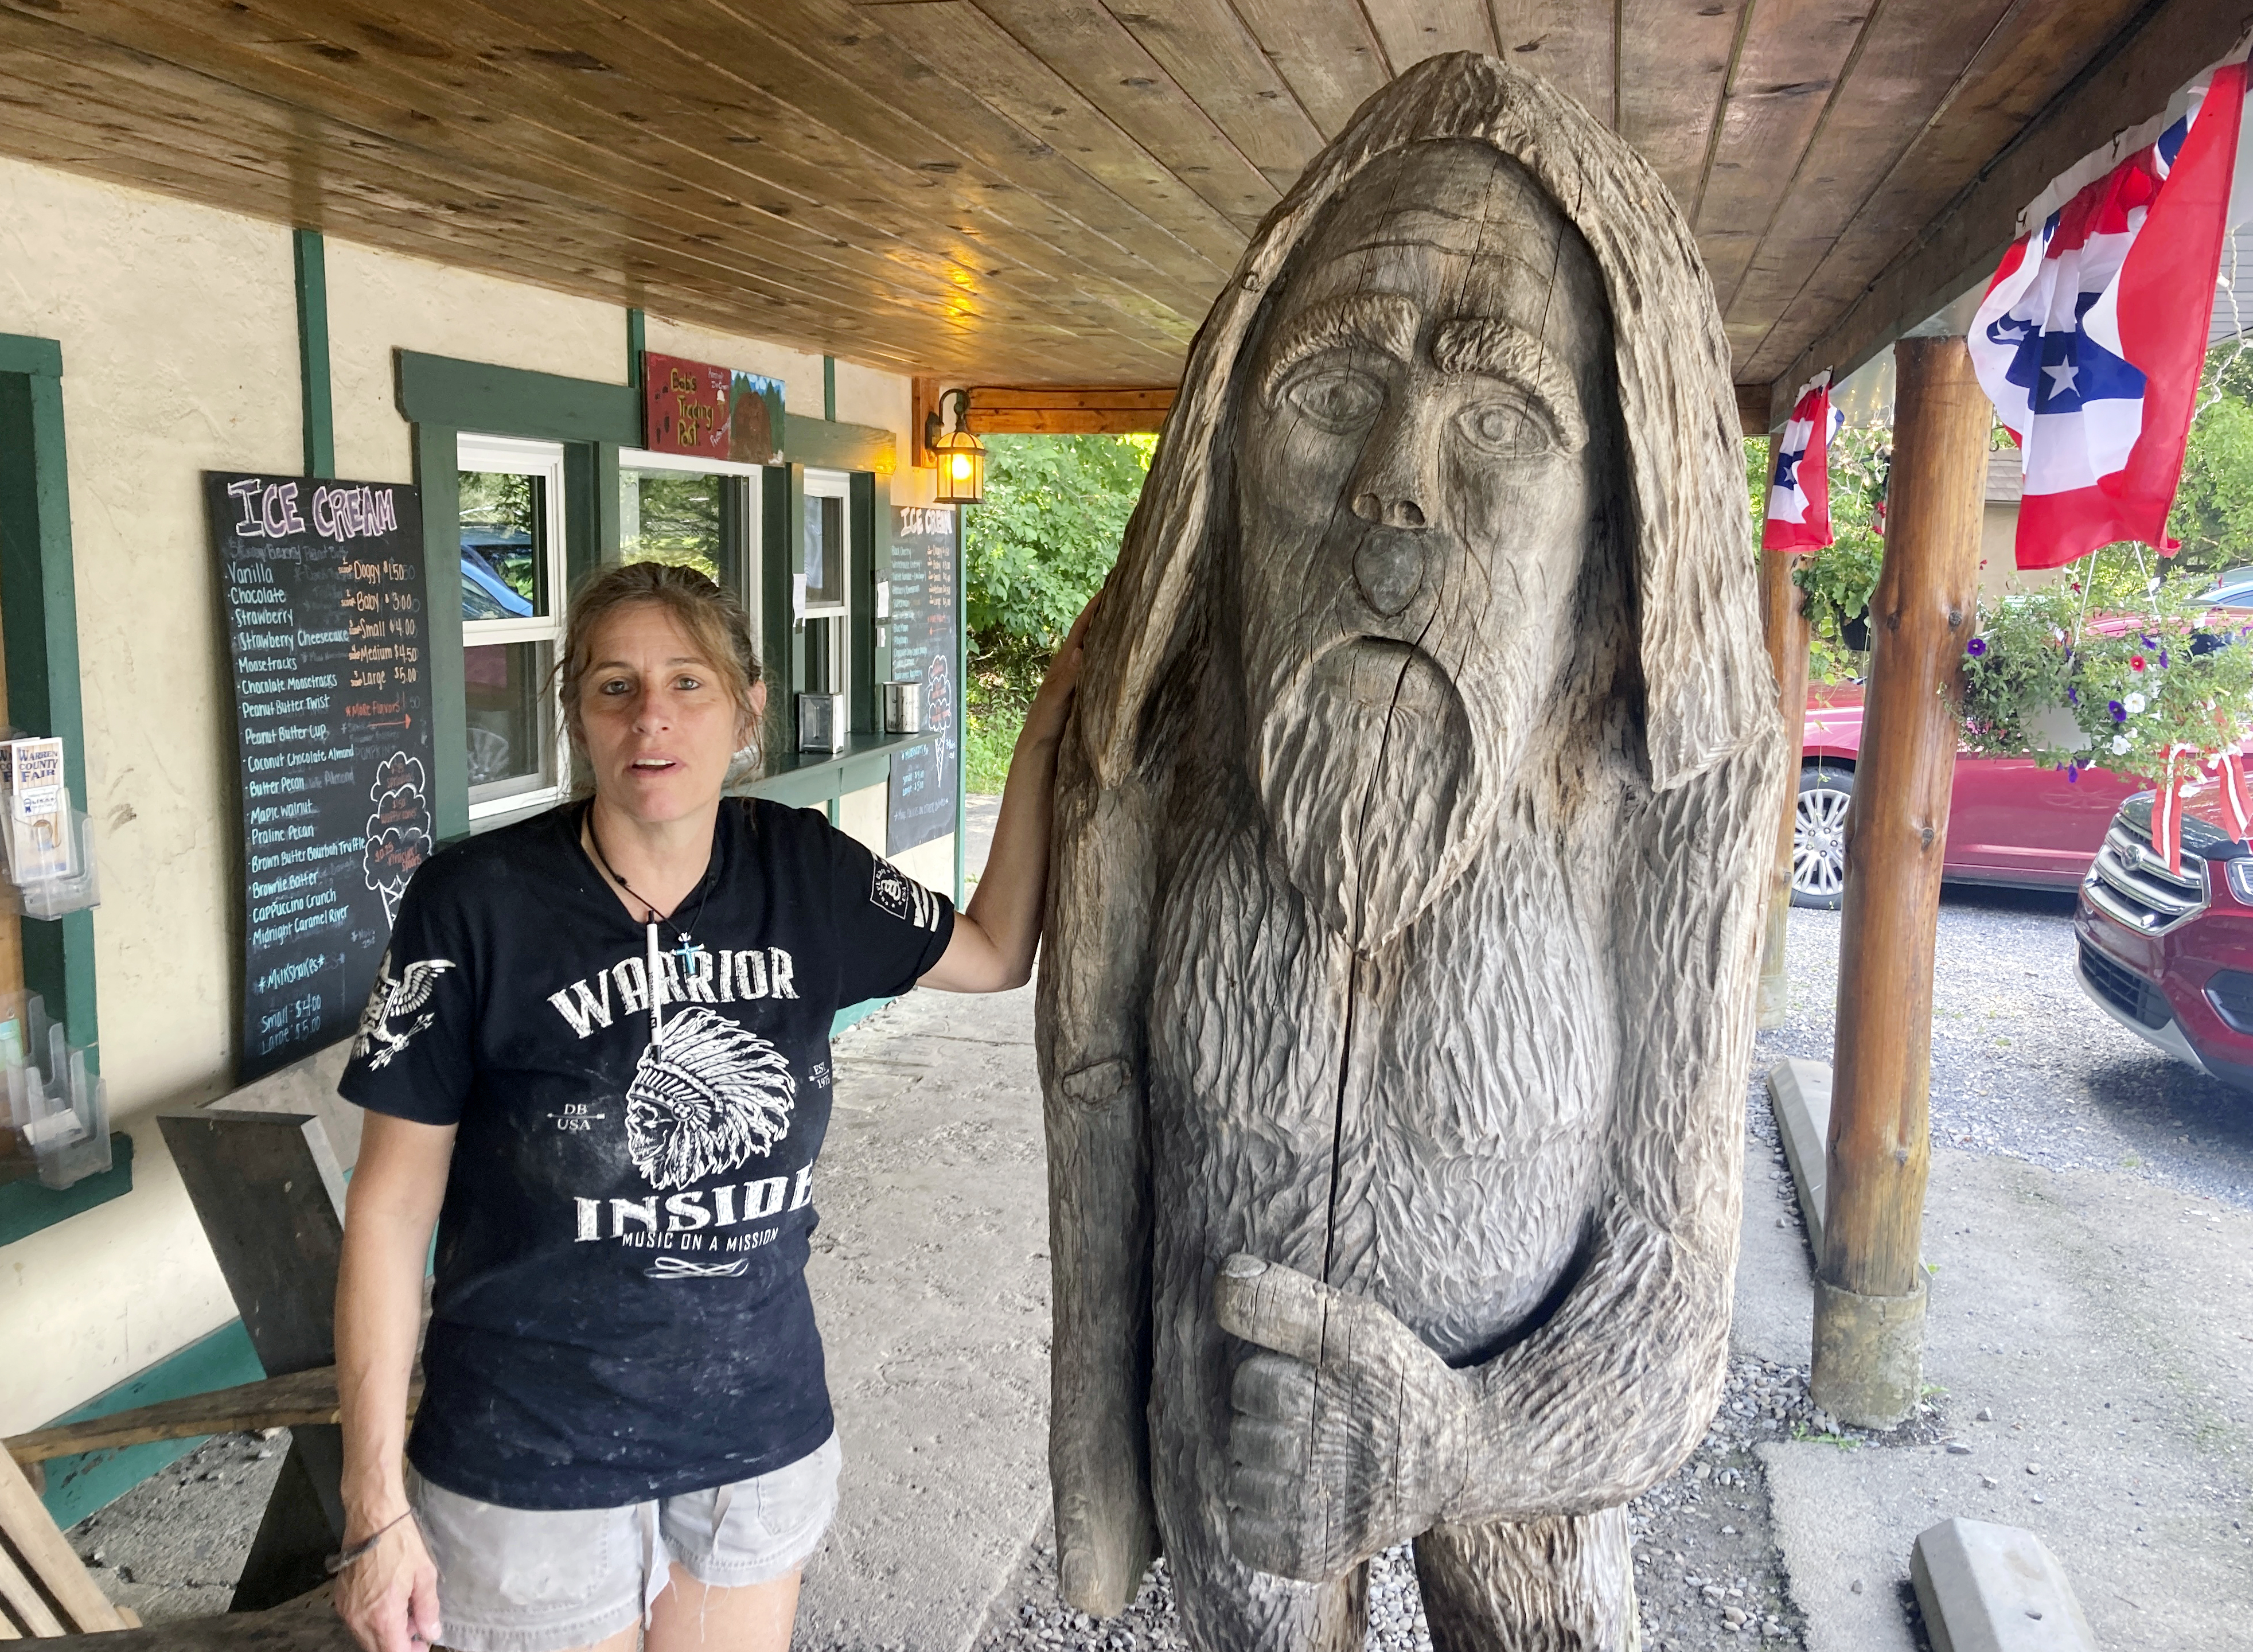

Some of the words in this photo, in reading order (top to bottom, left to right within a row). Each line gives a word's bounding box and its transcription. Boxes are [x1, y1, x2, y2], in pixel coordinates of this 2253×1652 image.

[677, 395, 714, 434] Trading
[677, 419, 700, 447] Post
[227, 478, 306, 539] ICE
[311, 485, 398, 542] CREAM
[900, 506, 923, 537] ICE
[925, 508, 953, 535] CREAM
[227, 562, 274, 585] Vanilla
[354, 560, 381, 585] Doggy
[230, 586, 287, 605] Chocolate
[356, 591, 379, 613] Baby
[236, 608, 294, 627] Strawberry
[360, 618, 385, 639] Small
[239, 632, 294, 652] Strawberry
[297, 629, 350, 646] Cheesecake
[238, 656, 298, 674] Moosetracks
[360, 644, 393, 663] Medium
[241, 677, 284, 695] Chocolate
[287, 673, 338, 691] Moosetracks
[362, 670, 387, 691] Large
[242, 702, 275, 719] Peanut
[275, 698, 304, 715] Butter
[305, 694, 331, 710] Twist
[245, 727, 278, 745] Peanut
[278, 725, 307, 742] Butter
[309, 723, 328, 740] Cup
[18, 749, 58, 762] WARREN
[19, 758, 59, 770] COUNTY
[248, 754, 284, 773] Coconut
[287, 750, 327, 767] Chocolate
[328, 744, 354, 761] Almond
[21, 769, 56, 782] FAIR
[250, 780, 279, 797] Butter
[281, 777, 305, 794] Pecan
[250, 806, 279, 825] Maple
[280, 799, 313, 817] Walnut
[252, 827, 284, 845] Praline
[288, 824, 314, 843] Pecan
[251, 855, 280, 873] Brown
[282, 850, 307, 867] Butter
[307, 843, 338, 862] Bourbon
[338, 837, 366, 857] Truffle
[252, 878, 287, 899] Brownie
[289, 871, 318, 889] Batter
[252, 901, 305, 924] Cappuccino
[306, 889, 337, 910] Crunch
[253, 923, 293, 946] Midnight
[294, 914, 329, 934] Caramel
[329, 905, 349, 922] River
[547, 947, 801, 1039] WARRIOR
[262, 1005, 288, 1034] Small
[262, 1027, 290, 1055] Large
[564, 1104, 587, 1116] DB
[557, 1119, 590, 1131] USA
[622, 1231, 673, 1250] MUSIC
[680, 1233, 703, 1250] ON
[709, 1234, 719, 1251] A
[726, 1226, 779, 1253] MISSION
